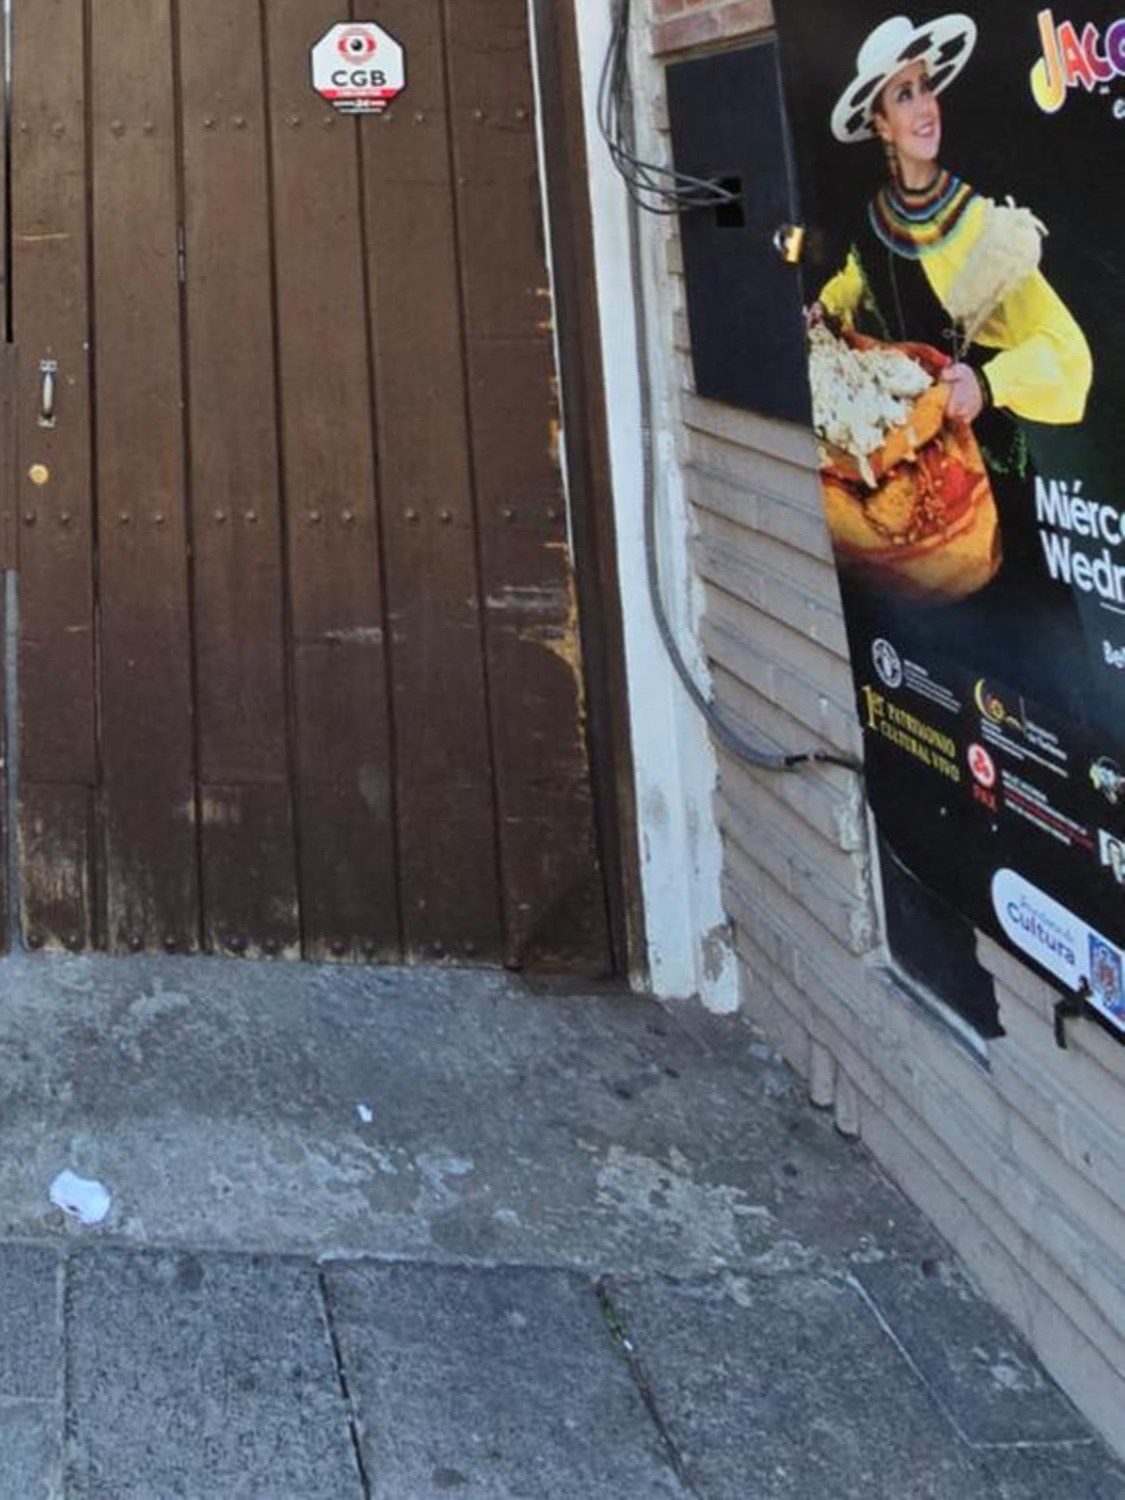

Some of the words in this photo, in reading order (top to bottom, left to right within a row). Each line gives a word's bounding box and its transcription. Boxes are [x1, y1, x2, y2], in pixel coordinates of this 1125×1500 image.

[331, 69, 387, 87] CGB
[1034, 474, 1125, 546] Miérc
[1007, 901, 1076, 966] Cultura
